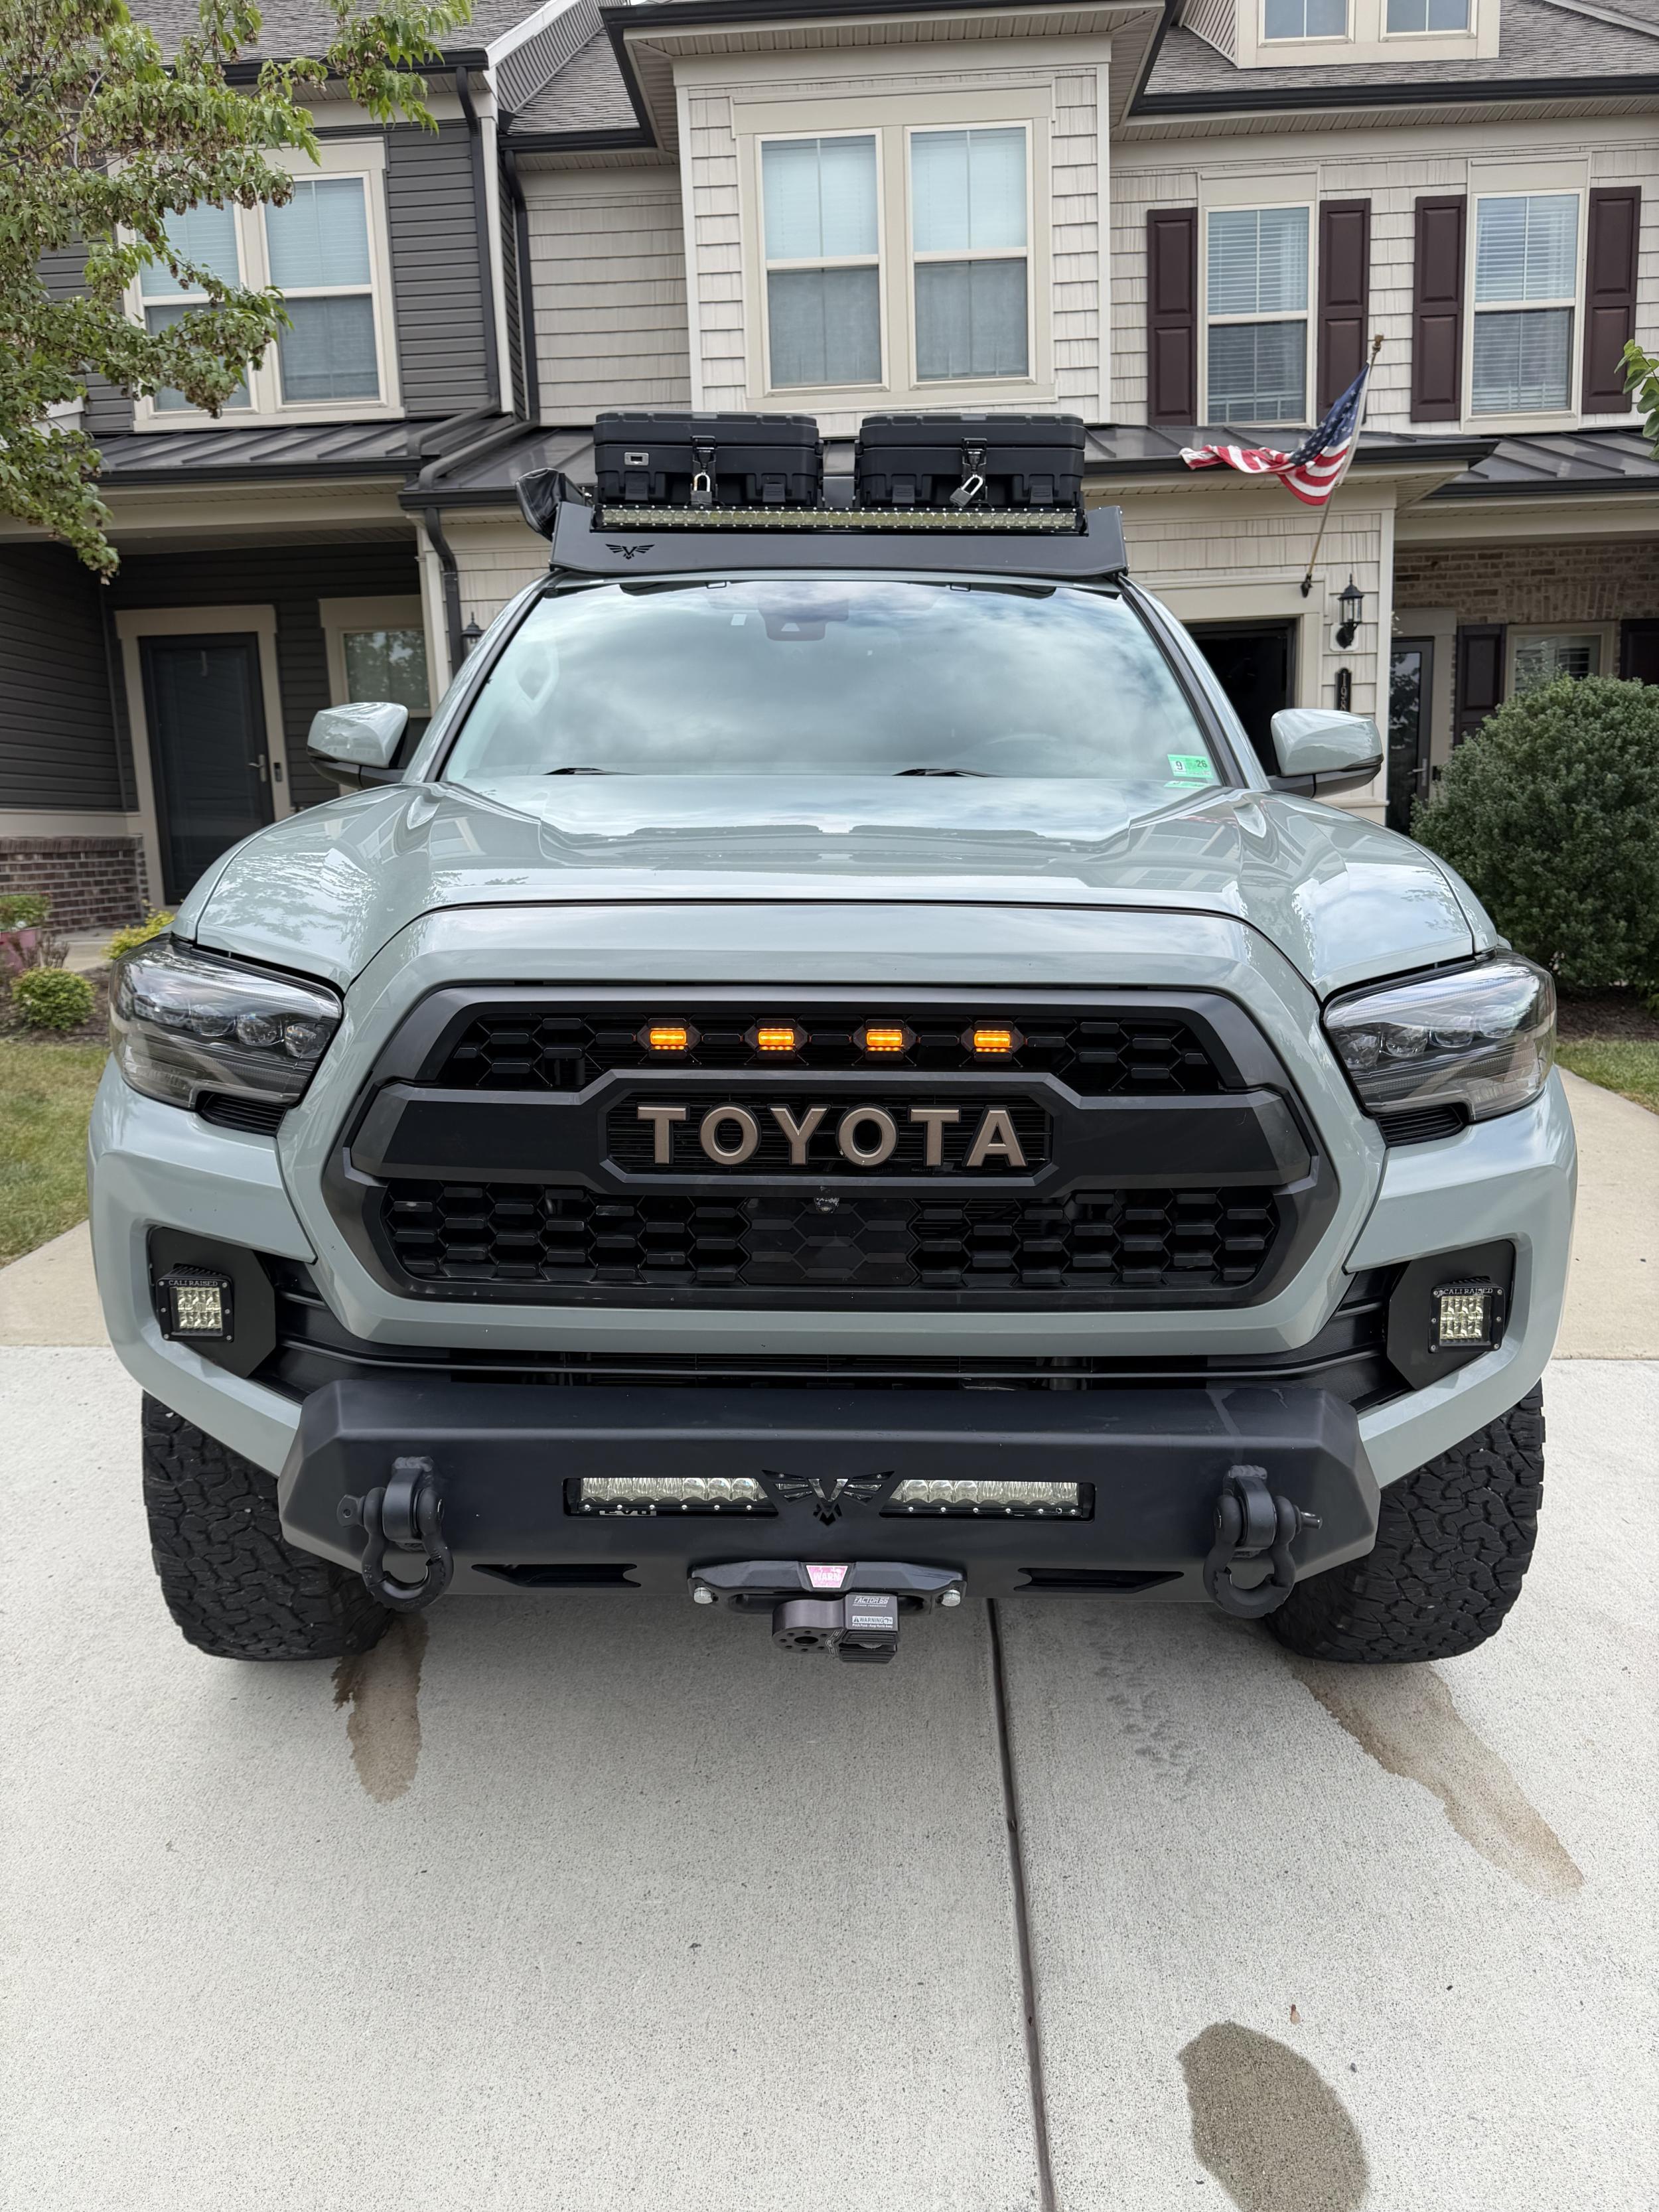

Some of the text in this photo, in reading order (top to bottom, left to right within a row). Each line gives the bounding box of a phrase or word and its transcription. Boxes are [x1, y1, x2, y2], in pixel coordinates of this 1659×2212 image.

[1176, 759, 1208, 770] 9 26
[637, 1105, 1028, 1167] TOYOTA
[813, 1572, 841, 1582] WARN
